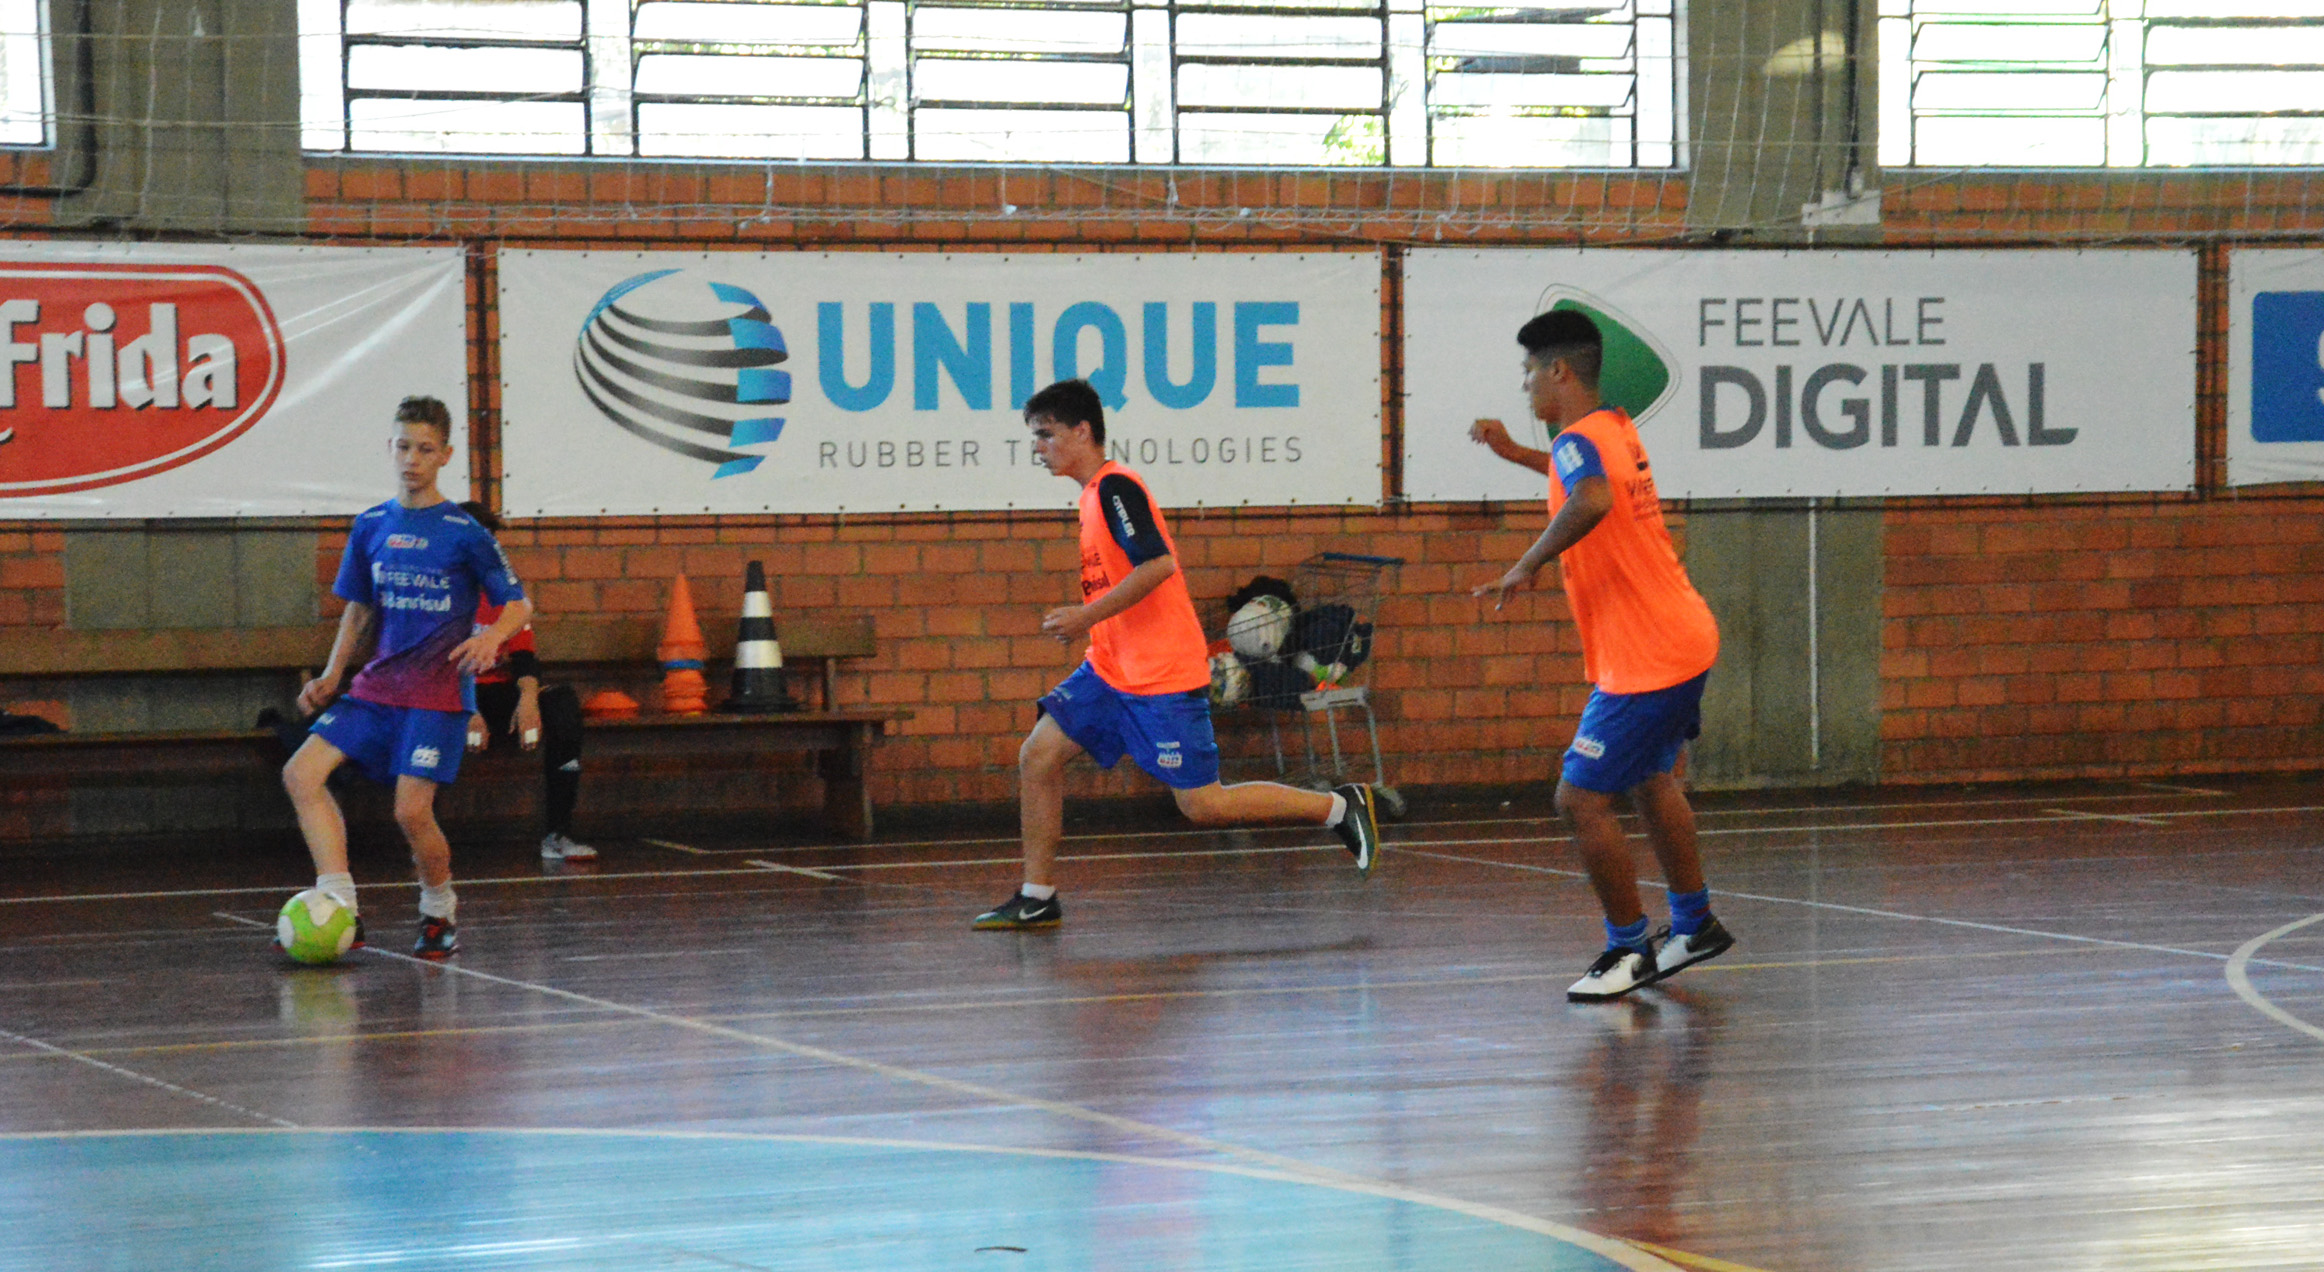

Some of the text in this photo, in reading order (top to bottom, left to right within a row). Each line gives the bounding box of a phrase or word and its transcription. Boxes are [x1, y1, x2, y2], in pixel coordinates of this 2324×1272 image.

[817, 300, 1300, 412] UNIQUE
[1699, 297, 1947, 347] FEEVALE
[1699, 362, 2080, 450] DIGITAL
[819, 437, 1303, 468] RUBBER TENOLOGIES
